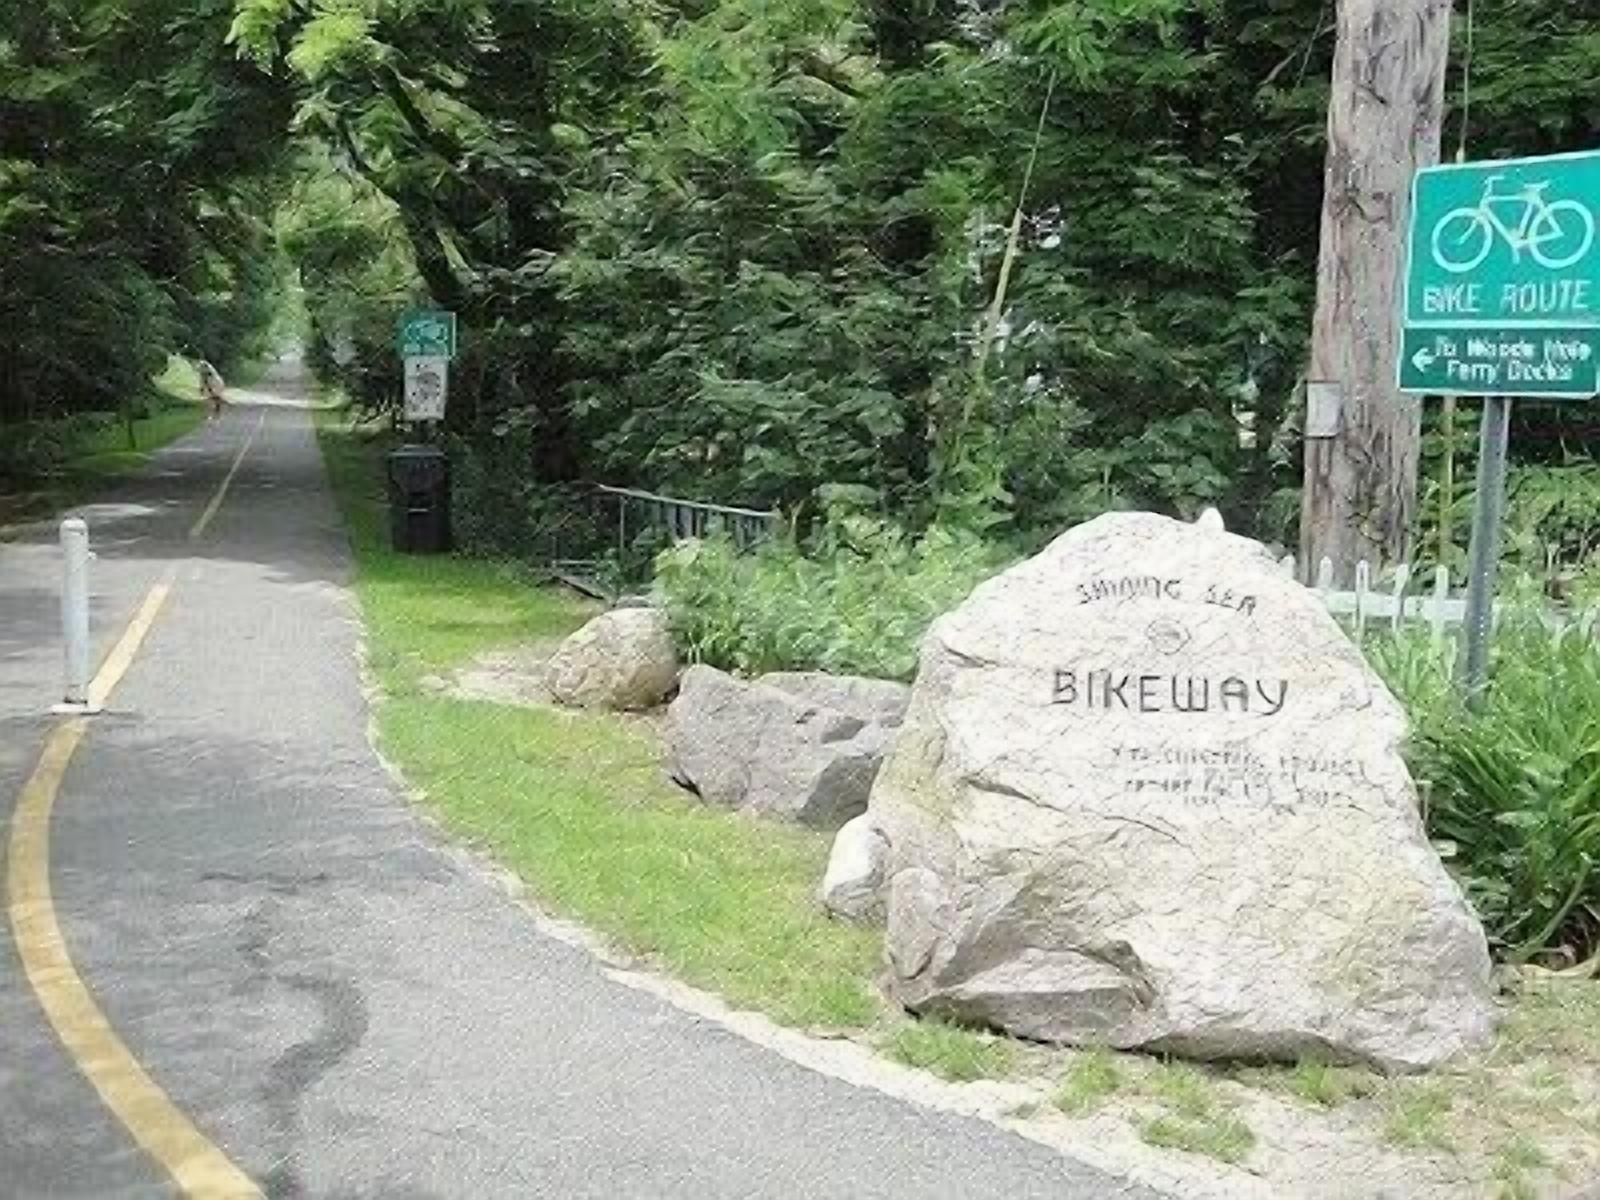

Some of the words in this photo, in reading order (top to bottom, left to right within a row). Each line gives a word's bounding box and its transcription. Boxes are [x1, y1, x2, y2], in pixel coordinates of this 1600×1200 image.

[1423, 285, 1482, 313] BIKE
[1502, 280, 1592, 312] ROUTE
[1447, 360, 1497, 384] Ferry
[1053, 669, 1288, 716] BIKEWAY
